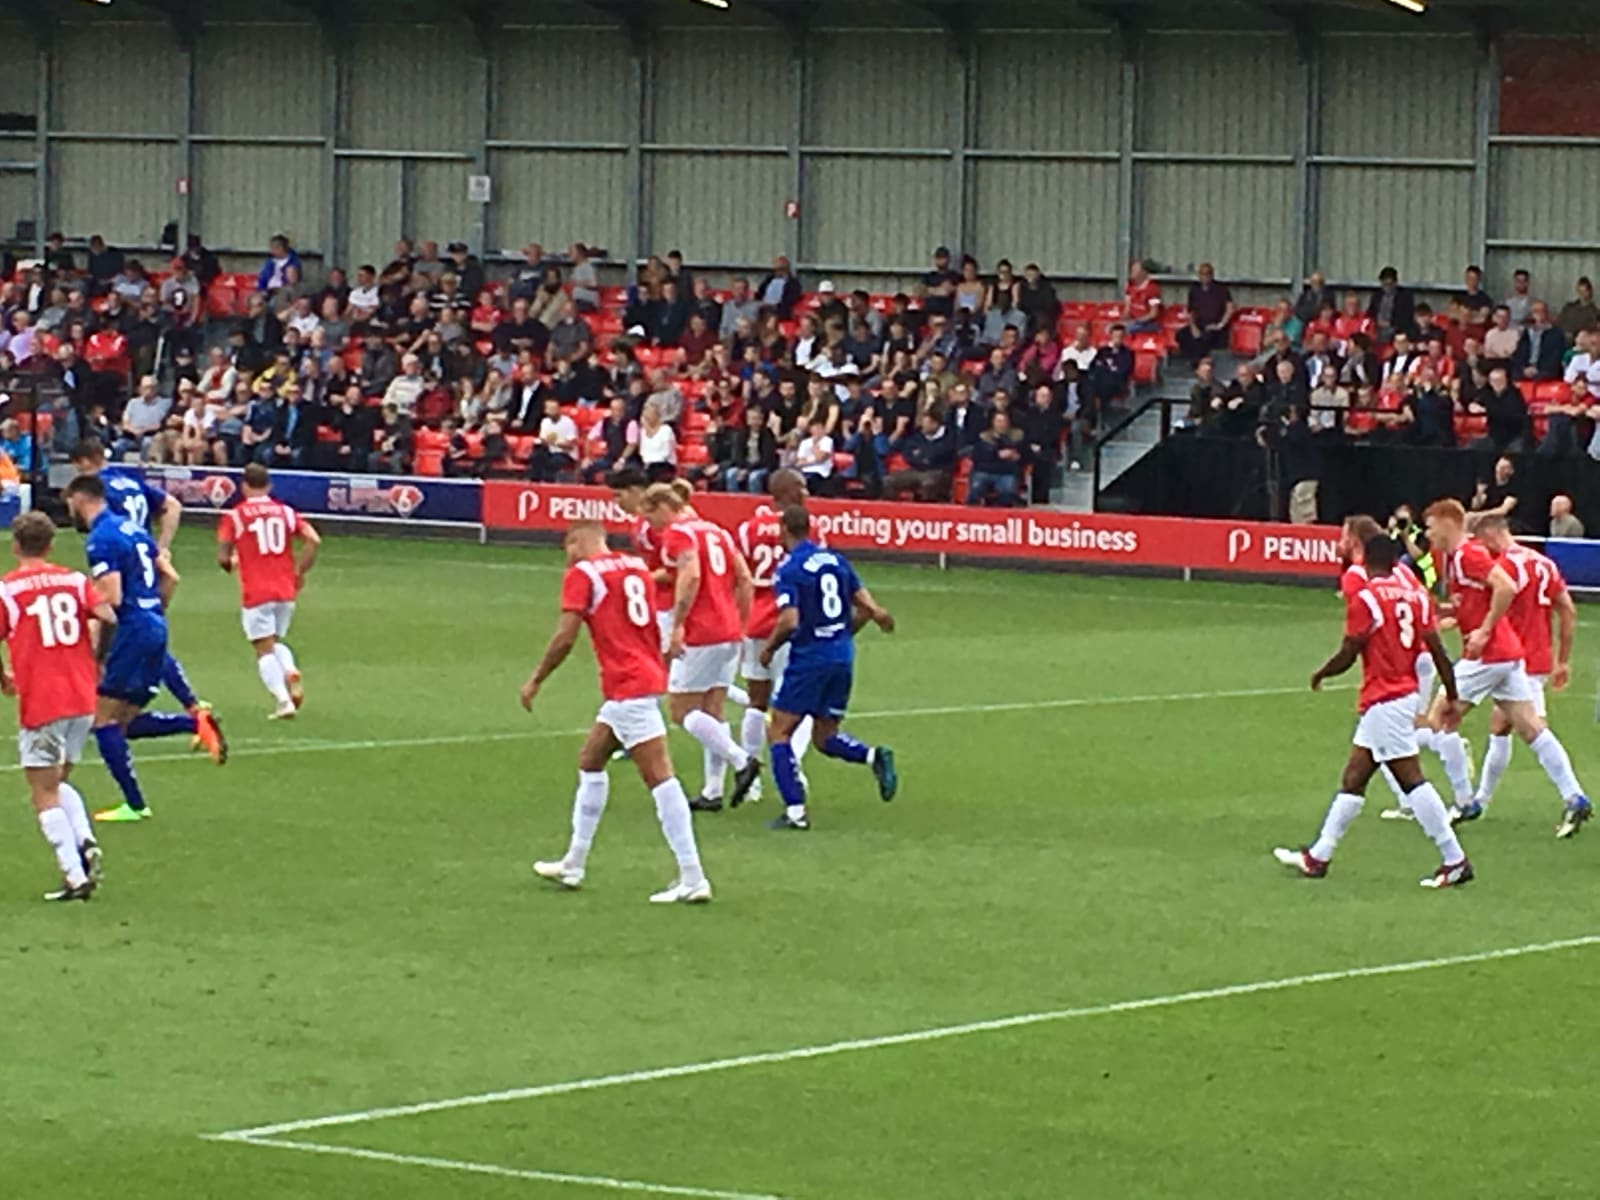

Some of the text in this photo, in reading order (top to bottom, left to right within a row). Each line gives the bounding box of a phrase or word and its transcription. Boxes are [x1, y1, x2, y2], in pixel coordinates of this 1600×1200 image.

[248, 517, 286, 554] 10
[705, 532, 726, 576] 6
[895, 518, 953, 545] your
[956, 519, 1022, 545] small
[1028, 519, 1137, 552] business
[1264, 536, 1343, 564] PENIN
[136, 543, 154, 588] 5
[1534, 562, 1551, 606] 2
[624, 574, 650, 627] 8
[820, 573, 842, 619] 8
[26, 592, 80, 648] 18
[1394, 602, 1415, 649] 3
